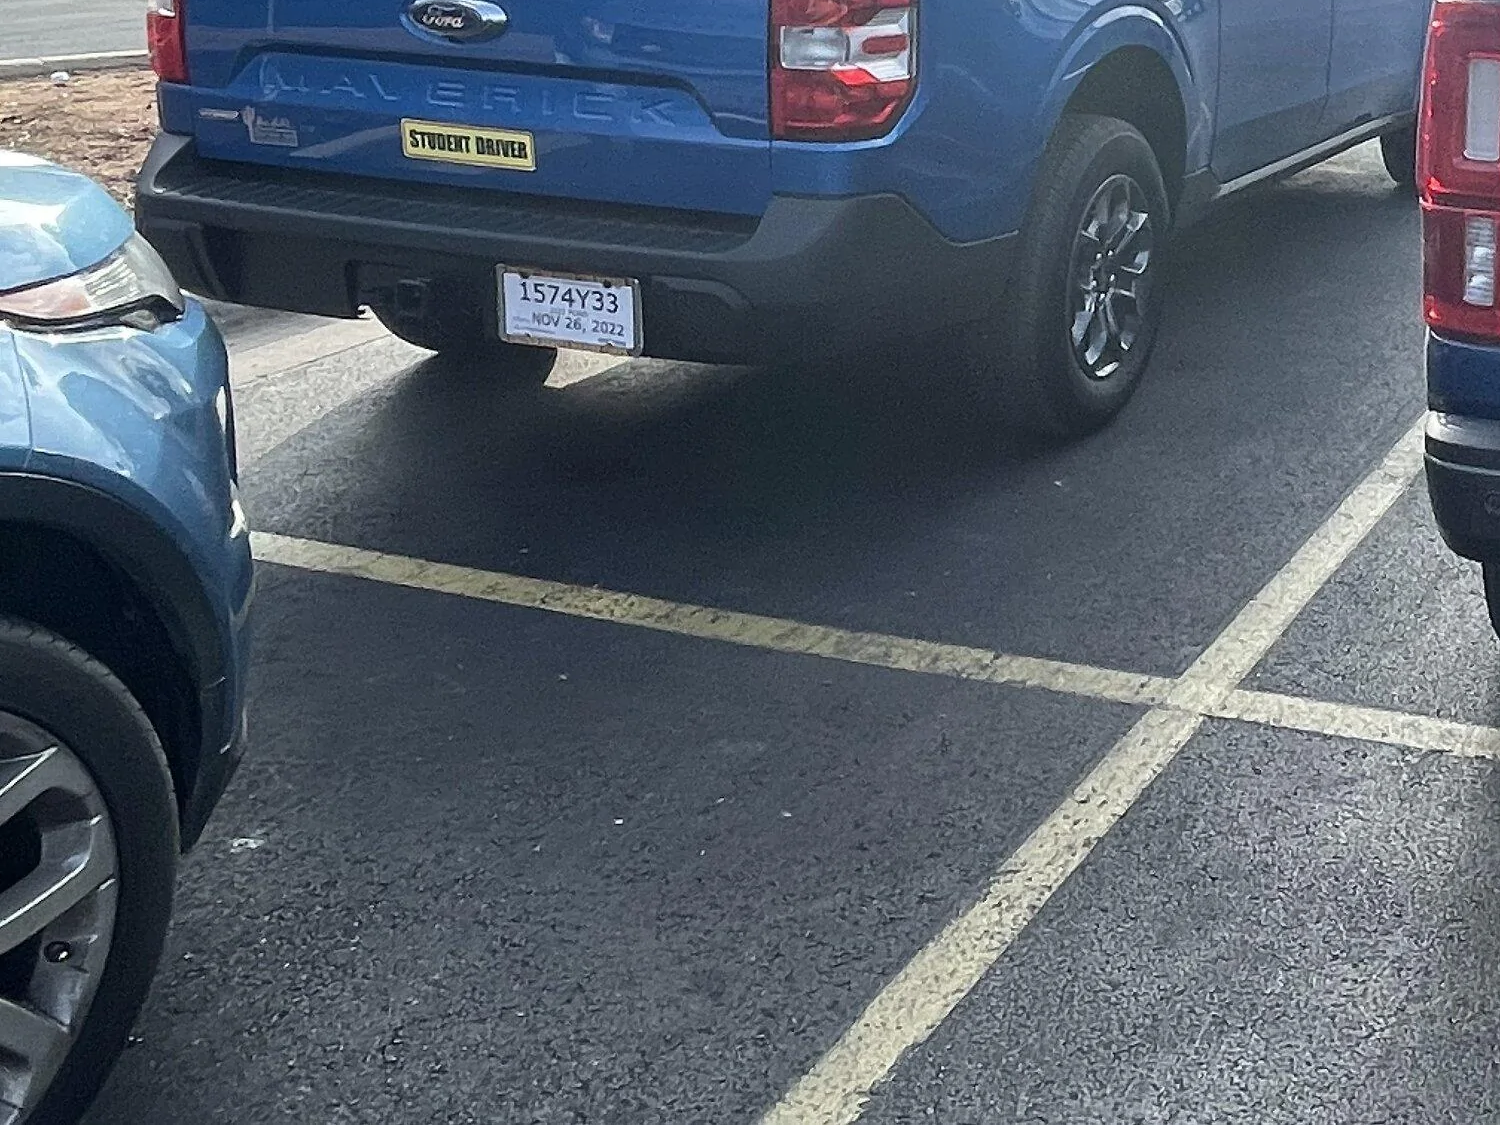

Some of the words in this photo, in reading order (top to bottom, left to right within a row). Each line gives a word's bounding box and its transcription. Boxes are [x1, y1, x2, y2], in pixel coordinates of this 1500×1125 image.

[421, 4, 466, 29] Ford
[409, 129, 471, 154] STUDENT
[475, 135, 528, 159] DRIVER
[520, 281, 619, 313] 1574Y33
[532, 312, 560, 328] NOV
[565, 317, 587, 334] 26,
[592, 319, 624, 337] 2022
